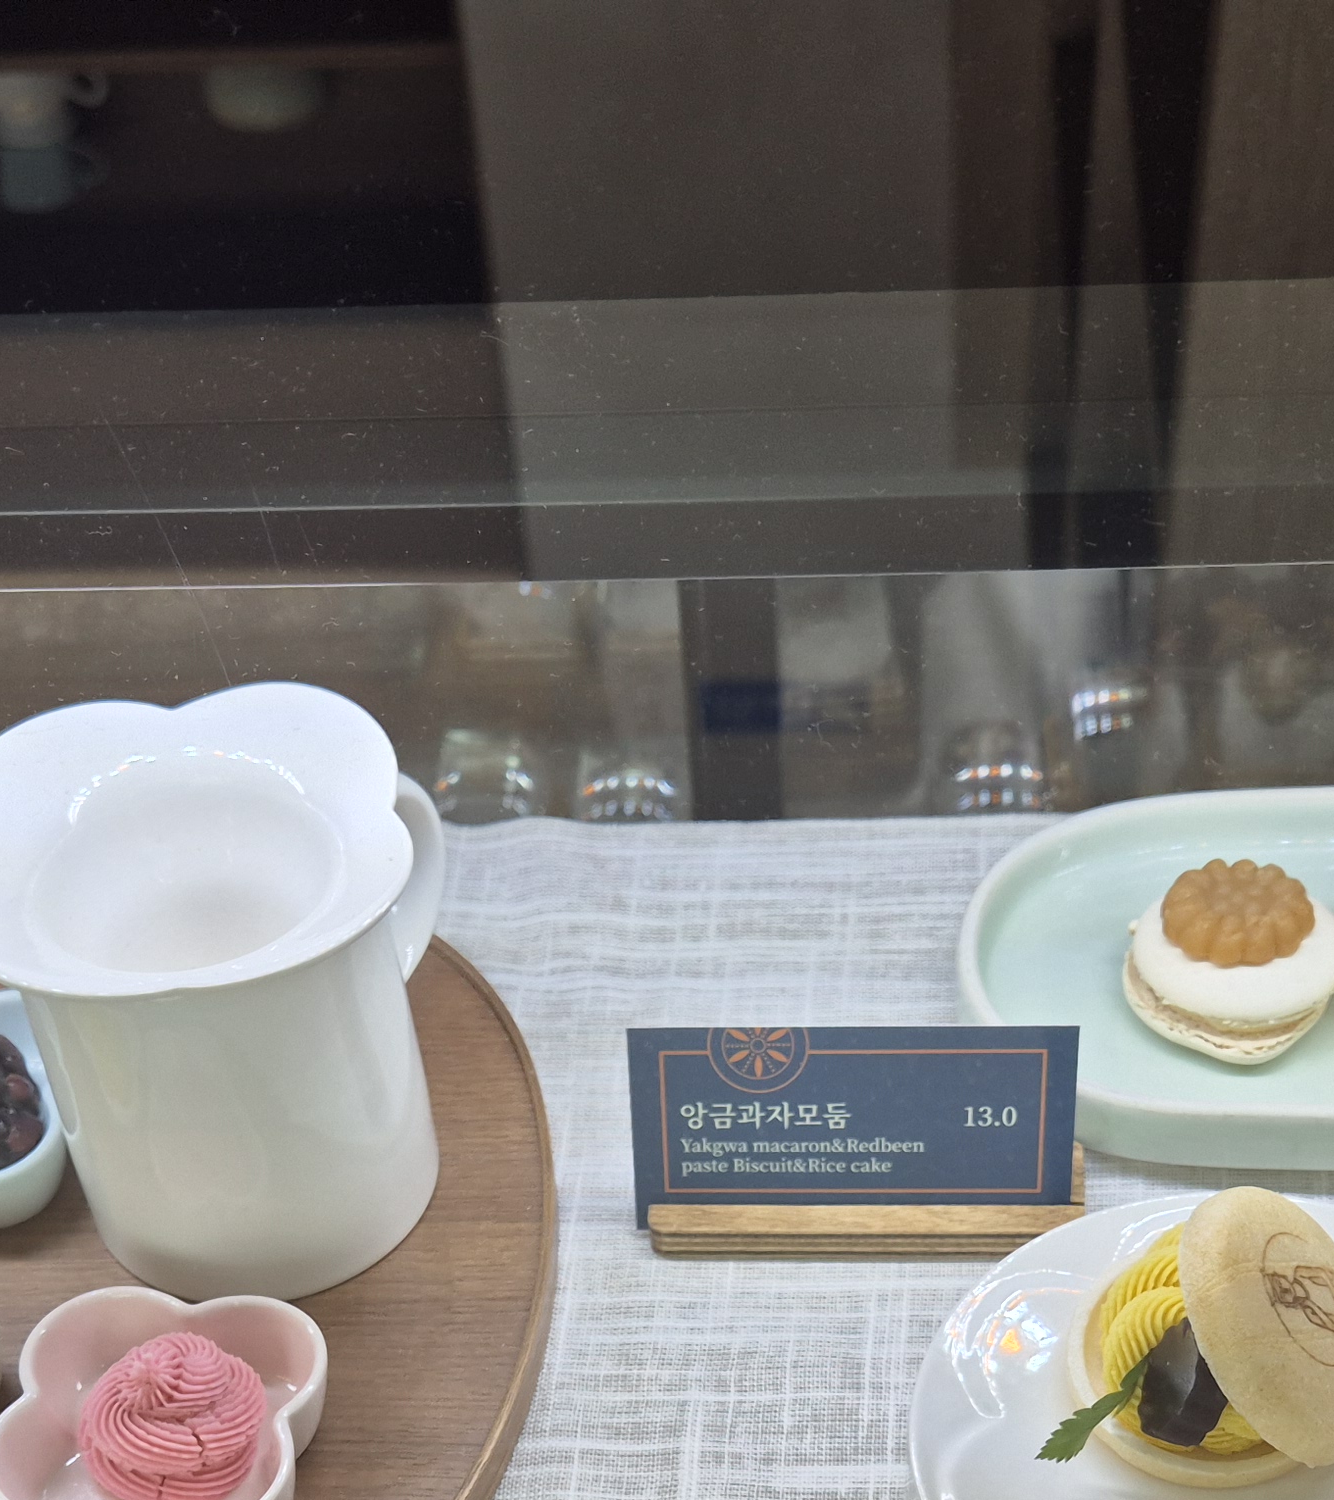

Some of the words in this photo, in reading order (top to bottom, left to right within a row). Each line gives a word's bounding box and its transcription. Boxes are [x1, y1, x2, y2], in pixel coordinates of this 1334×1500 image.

[680, 1101, 852, 1130] 앙금과자모둠
[963, 1105, 1018, 1128] 13.0
[680, 1137, 749, 1157] Yakgwa
[752, 1137, 925, 1153] macaron&Redbeen
[681, 1160, 729, 1177] paste
[733, 1157, 846, 1173] Biscuit&Rice
[850, 1157, 893, 1173] cake
